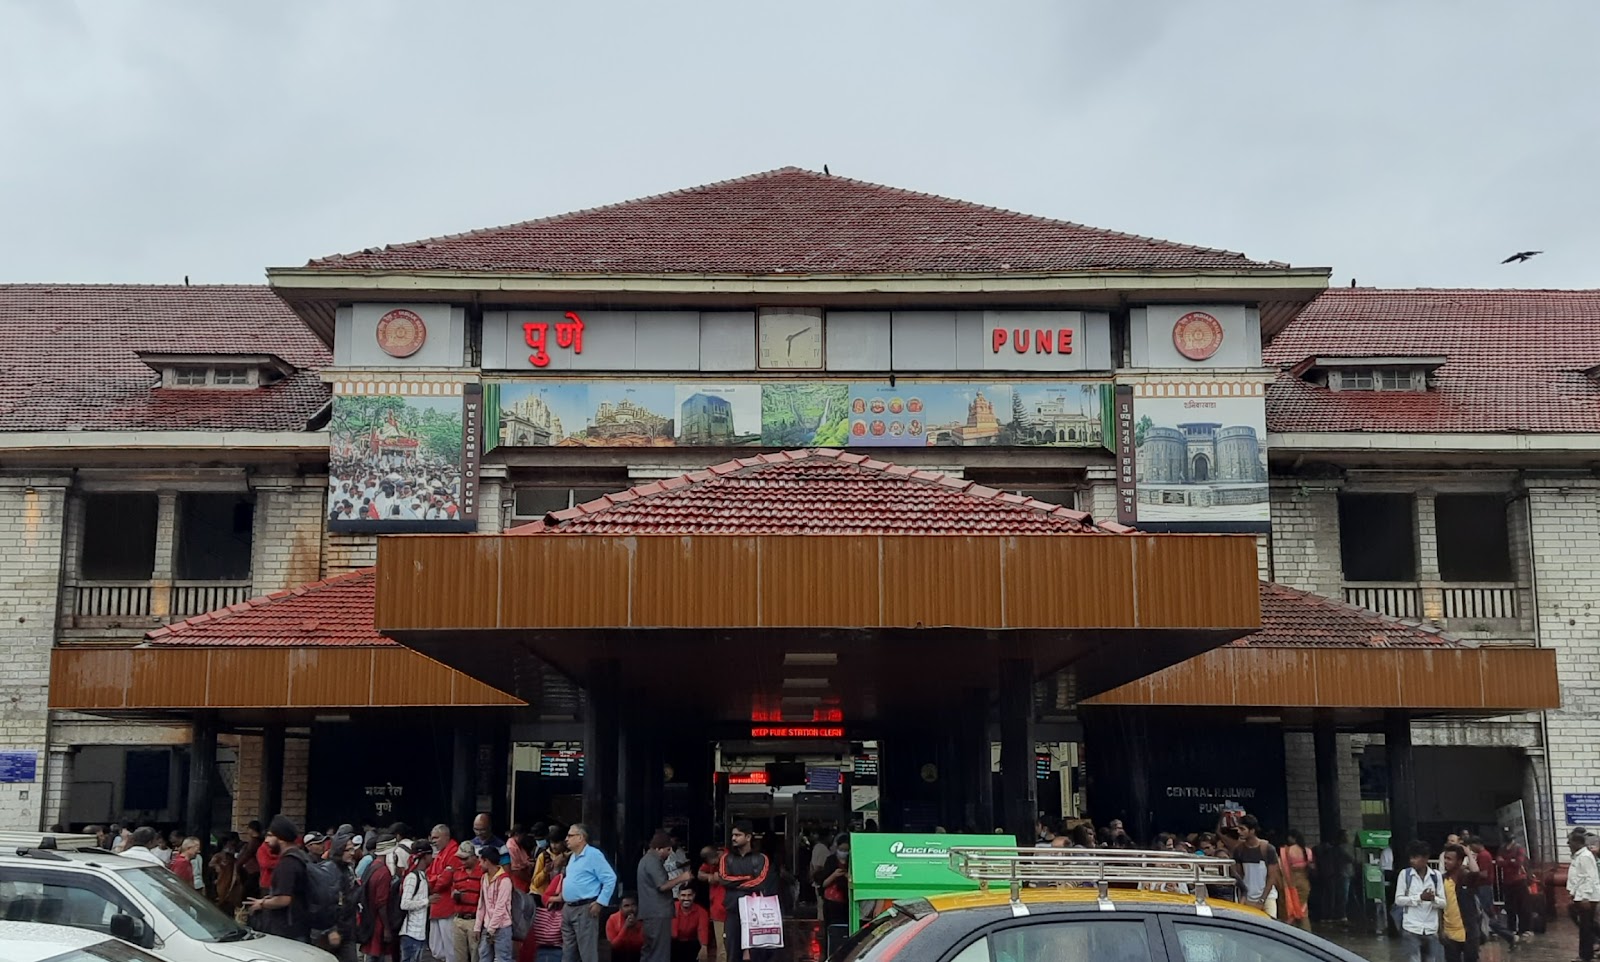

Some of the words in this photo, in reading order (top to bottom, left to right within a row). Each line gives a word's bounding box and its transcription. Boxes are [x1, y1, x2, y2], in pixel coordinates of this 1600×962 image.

[523, 311, 585, 368] पुणे
[993, 328, 1073, 354] PUNE
[466, 403, 477, 458] WELCOME
[465, 462, 474, 478] TO
[465, 482, 473, 514] PUNE
[751, 728, 769, 737] KEEP
[788, 728, 819, 737] STATION
[1166, 786, 1213, 798] CENTRAL
[1214, 787, 1256, 798] RAILWAY
[375, 798, 392, 817] पुणे
